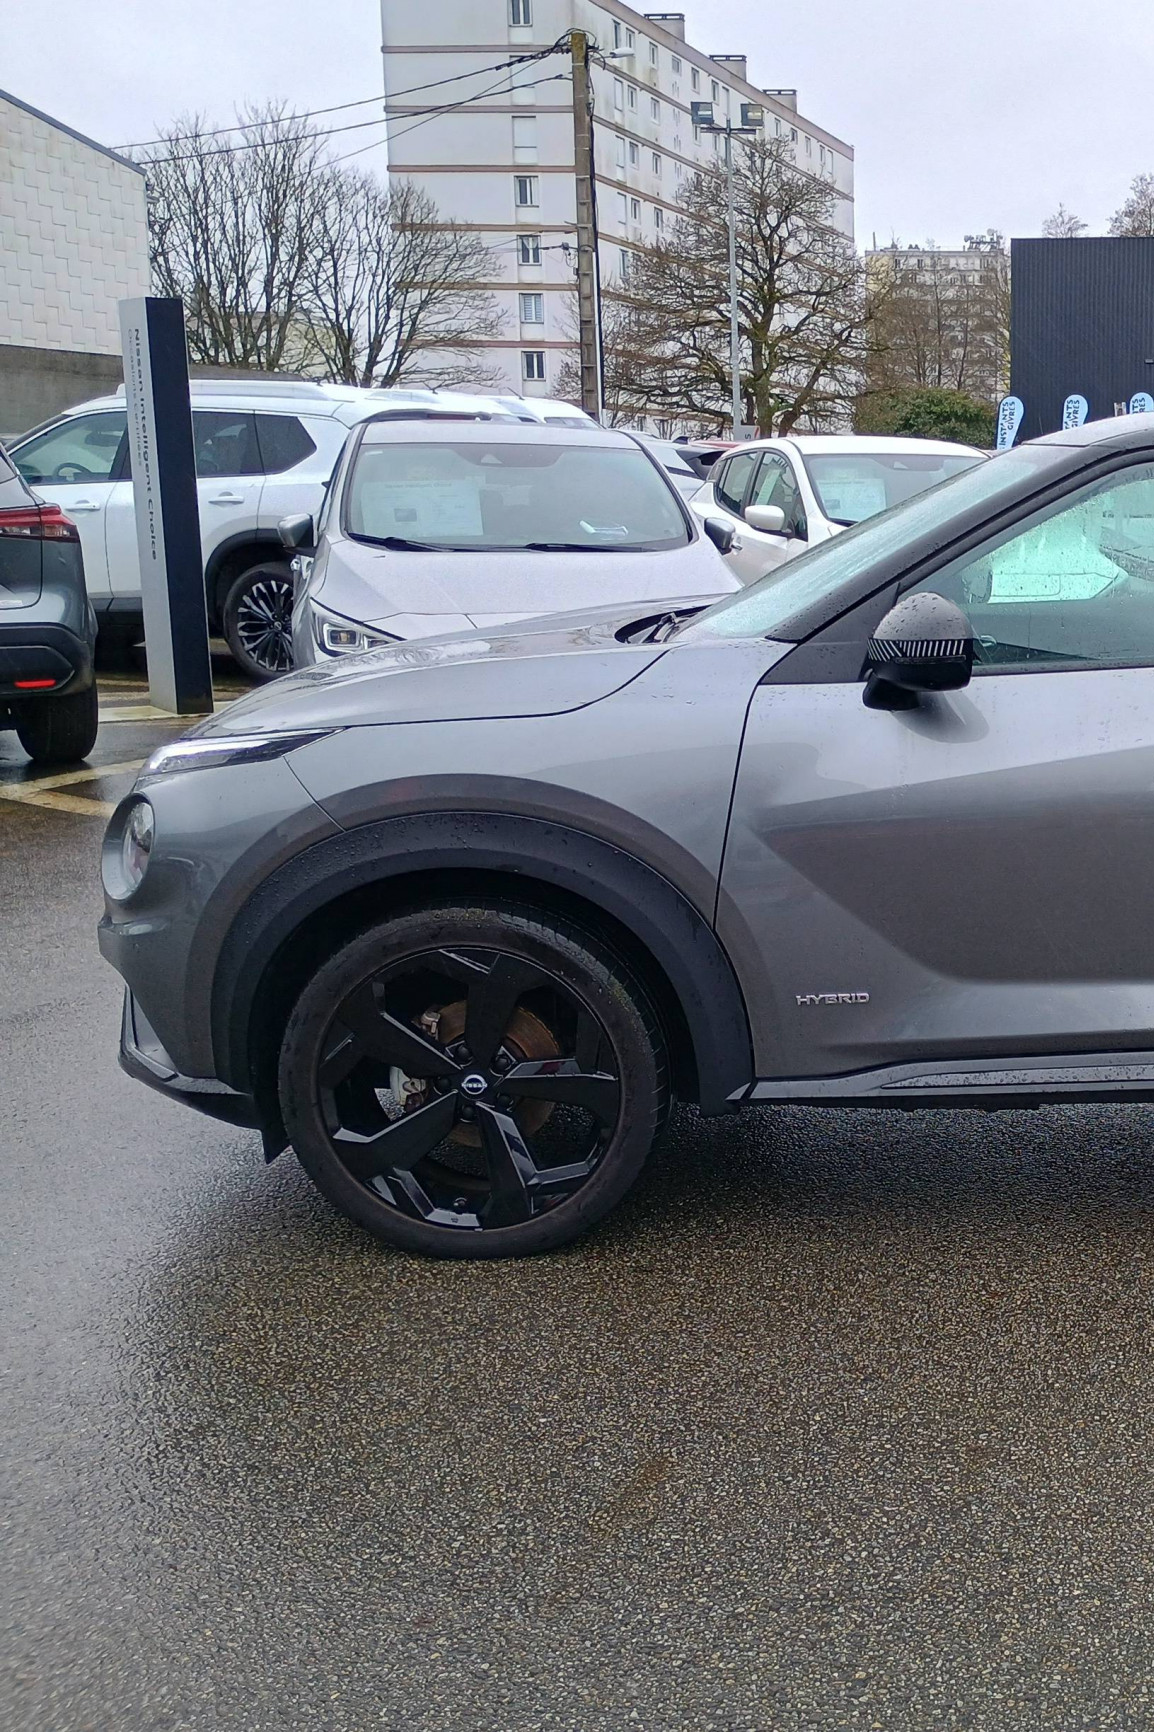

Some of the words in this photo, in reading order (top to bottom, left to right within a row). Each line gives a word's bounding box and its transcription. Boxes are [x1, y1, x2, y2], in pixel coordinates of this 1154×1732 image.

[134, 328, 143, 392] Nissan
[140, 398, 152, 492] Intelligent
[148, 498, 157, 560] Choice
[796, 993, 870, 1006] HYBRID
